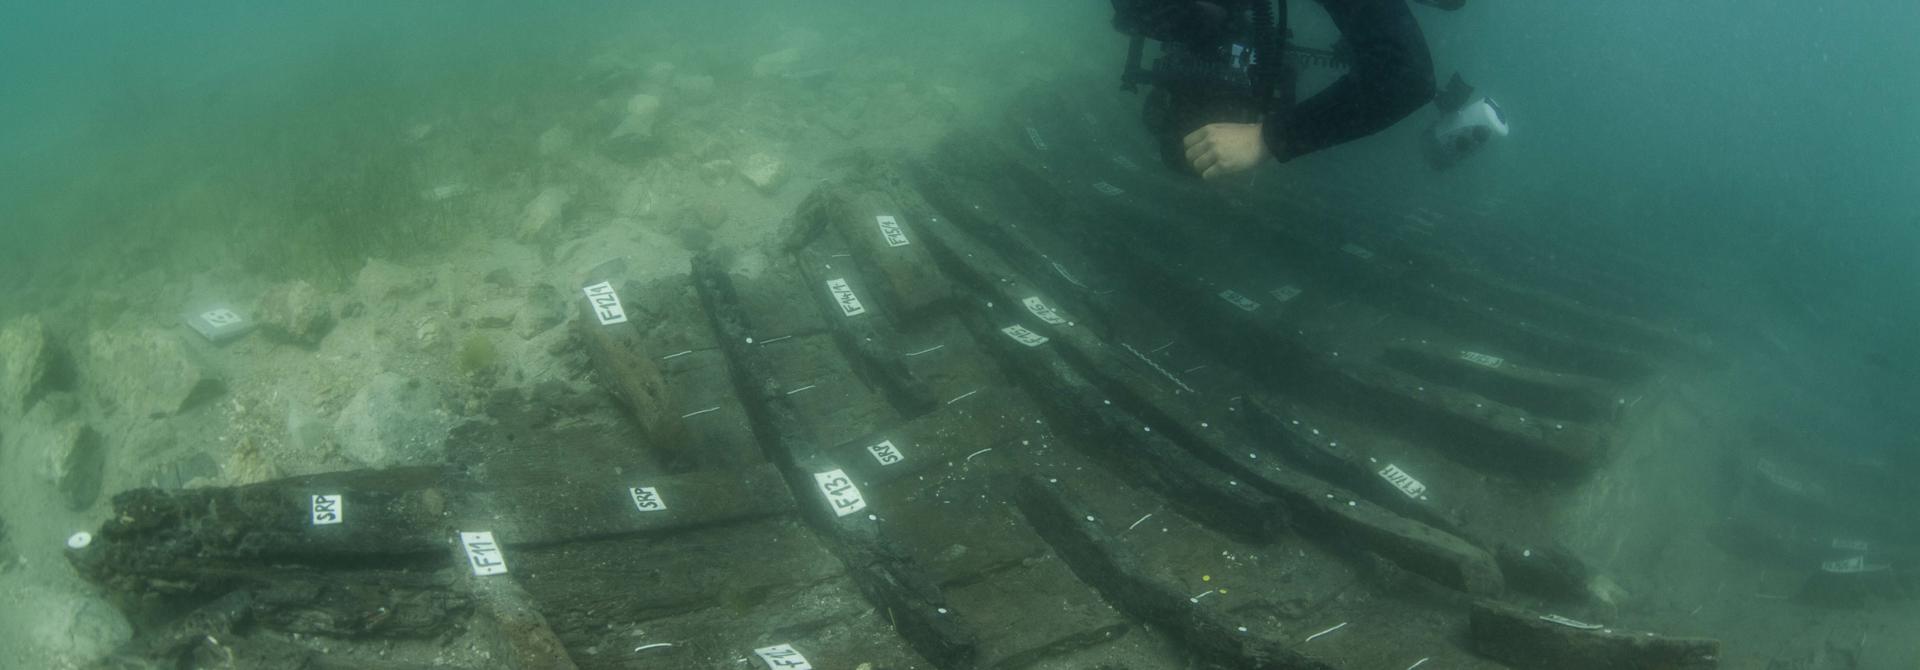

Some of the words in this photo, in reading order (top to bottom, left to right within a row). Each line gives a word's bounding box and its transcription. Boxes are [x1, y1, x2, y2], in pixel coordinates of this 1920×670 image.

[589, 285, 622, 321] F12/1
[872, 445, 898, 462] SRP
[315, 495, 336, 521] SRP
[634, 488, 658, 508] SRP
